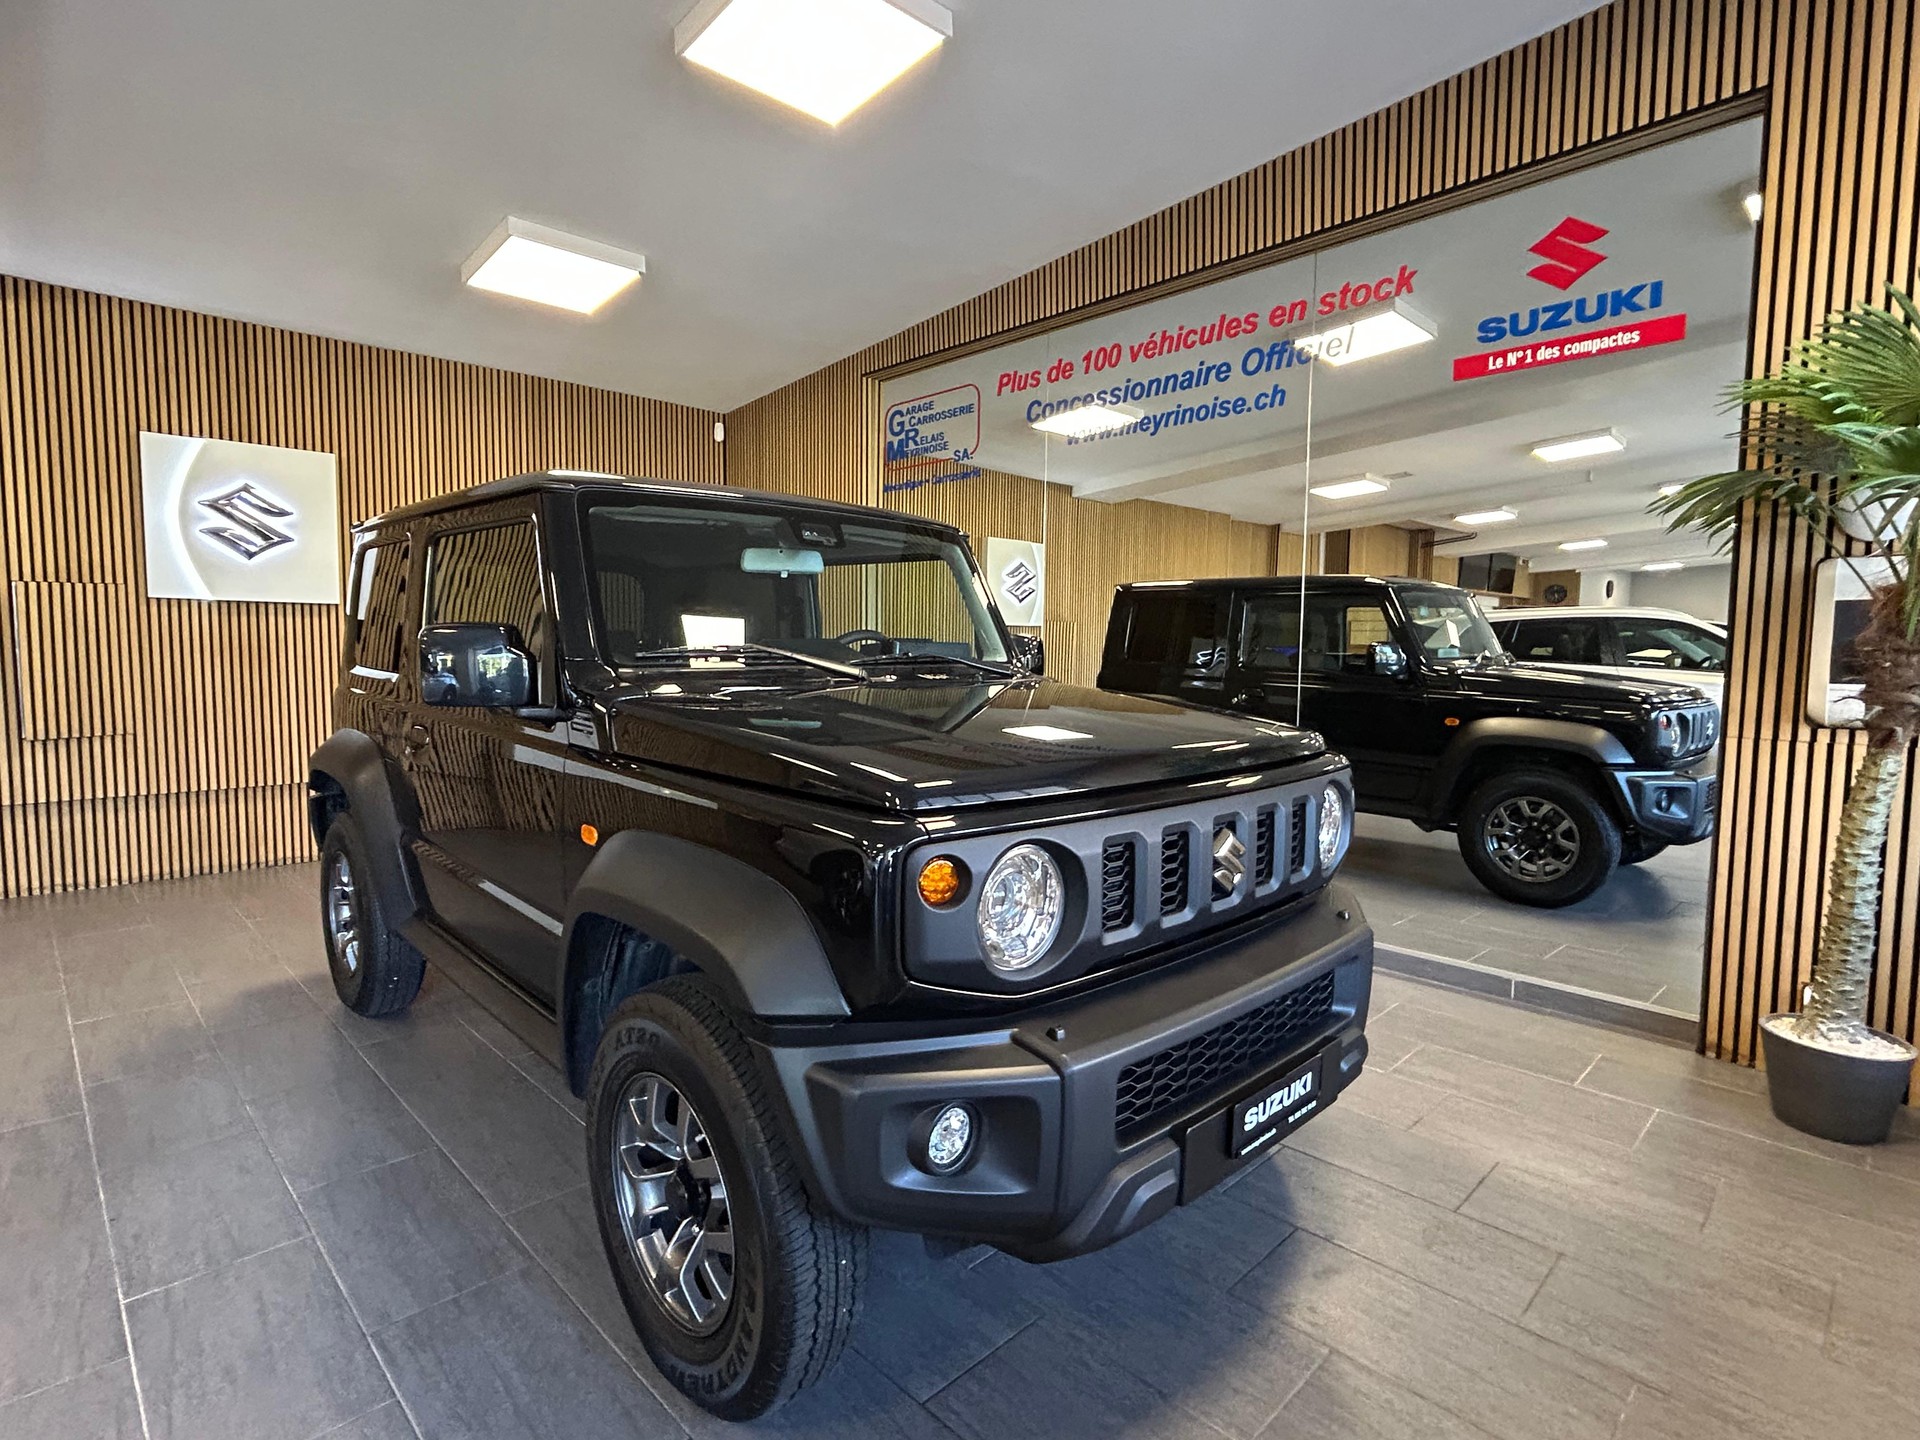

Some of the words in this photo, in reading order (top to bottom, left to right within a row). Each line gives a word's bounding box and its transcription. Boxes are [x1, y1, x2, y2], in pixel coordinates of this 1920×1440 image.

[997, 370, 1041, 396] Plus
[1047, 358, 1074, 384] de
[1081, 343, 1122, 373] 100
[1129, 311, 1260, 363] véhicules
[1268, 298, 1307, 328] en
[1317, 264, 1419, 316] stock
[1476, 280, 1663, 343] SUZUKI
[1488, 355, 1504, 371] Le
[1536, 344, 1560, 362] des
[1563, 329, 1641, 357] compactes
[908, 403, 975, 427] CARROSSERIE
[1026, 360, 1231, 423] Concessionnaire
[904, 427, 945, 449] RELAIS
[1243, 1071, 1313, 1132] SUZUKI
